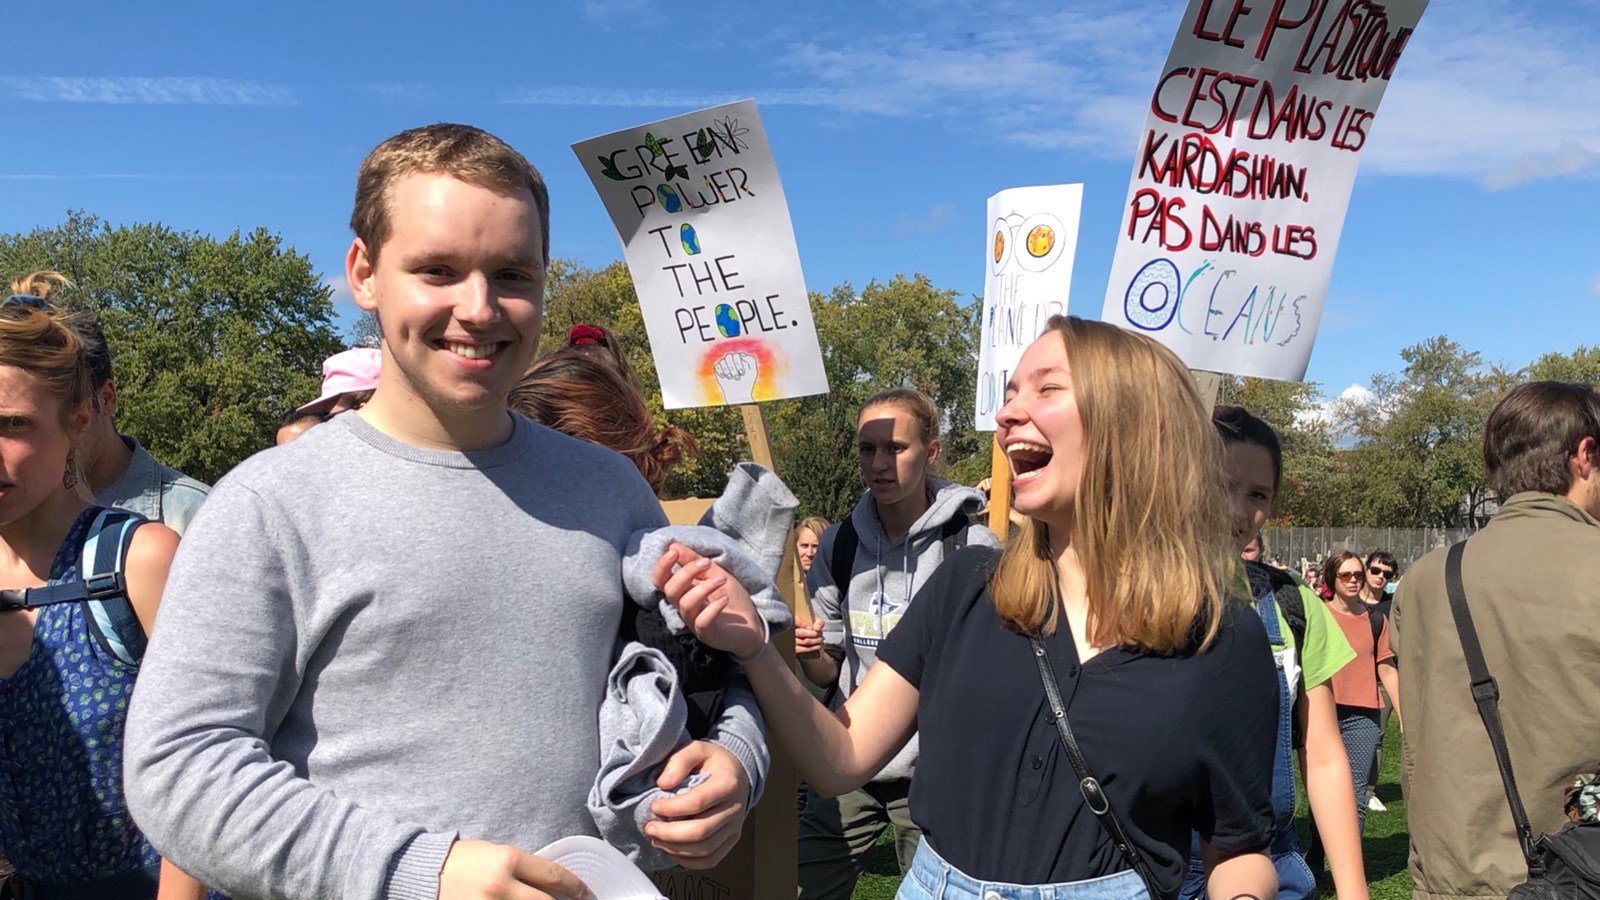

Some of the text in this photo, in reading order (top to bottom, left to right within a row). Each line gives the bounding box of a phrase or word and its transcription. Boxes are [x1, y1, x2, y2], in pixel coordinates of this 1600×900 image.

[1192, 0, 1252, 48] LE
[1150, 67, 1376, 152] C'EST DANS LES
[609, 122, 742, 180] GREEN
[630, 167, 756, 218] POWER
[648, 223, 702, 258] TO
[1128, 188, 1318, 261] PAS DANS LES
[662, 255, 745, 297] THE
[674, 294, 799, 344] PEOPLE.
[1124, 258, 1308, 347] OCEANS
